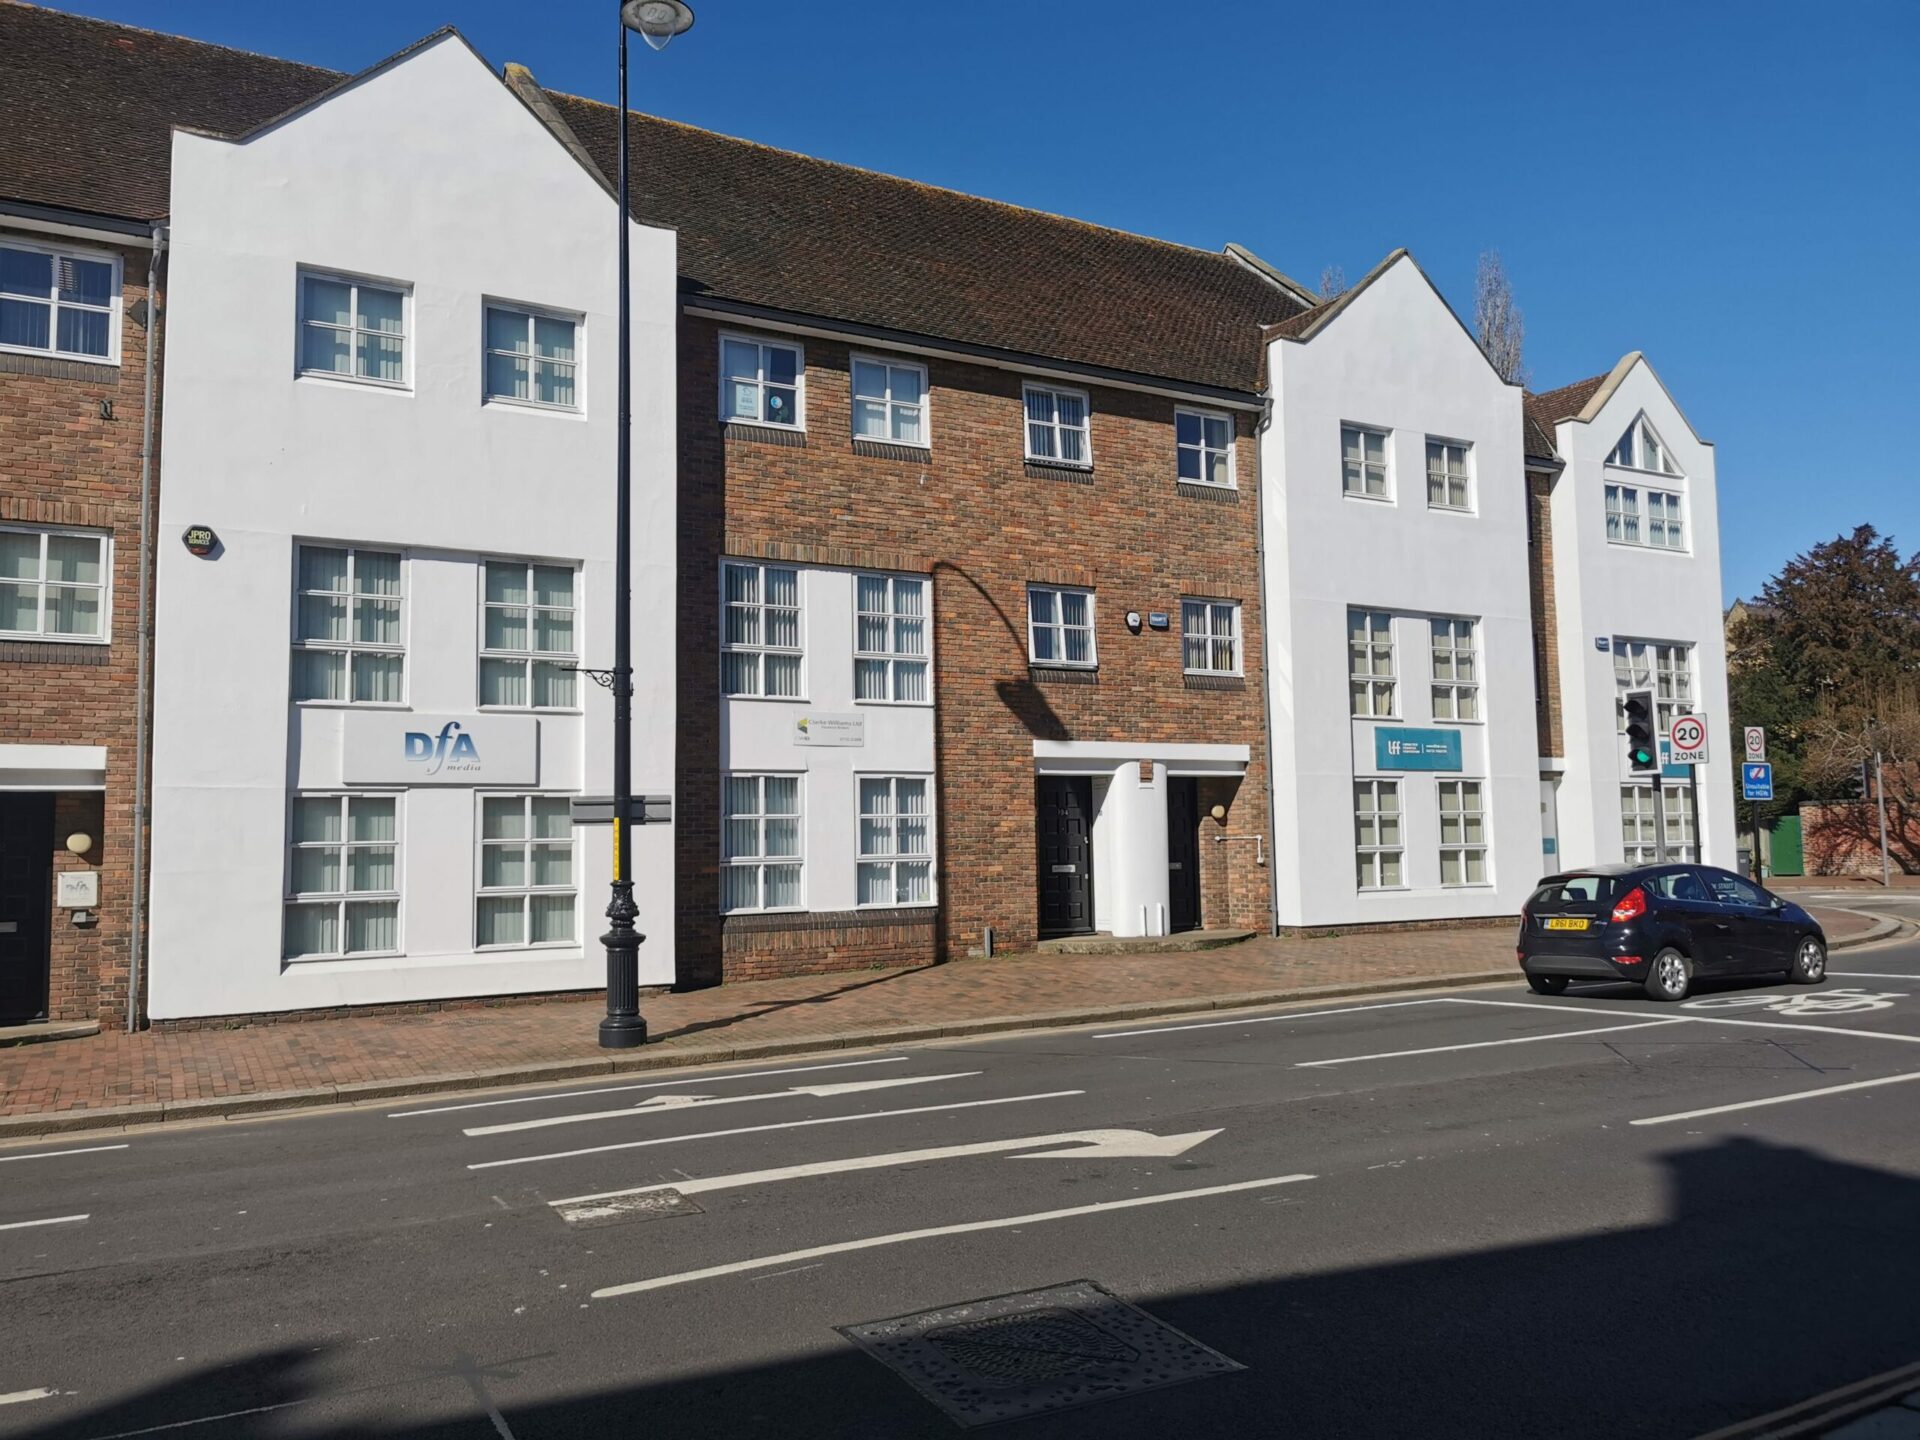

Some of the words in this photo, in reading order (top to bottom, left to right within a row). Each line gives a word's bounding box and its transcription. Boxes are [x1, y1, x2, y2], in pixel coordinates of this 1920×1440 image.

[188, 530, 211, 540] JPRO
[1677, 727, 1700, 741] 20
[1750, 736, 1760, 744] 20
[405, 721, 480, 776] DfA
[1674, 751, 1704, 761] ZONE
